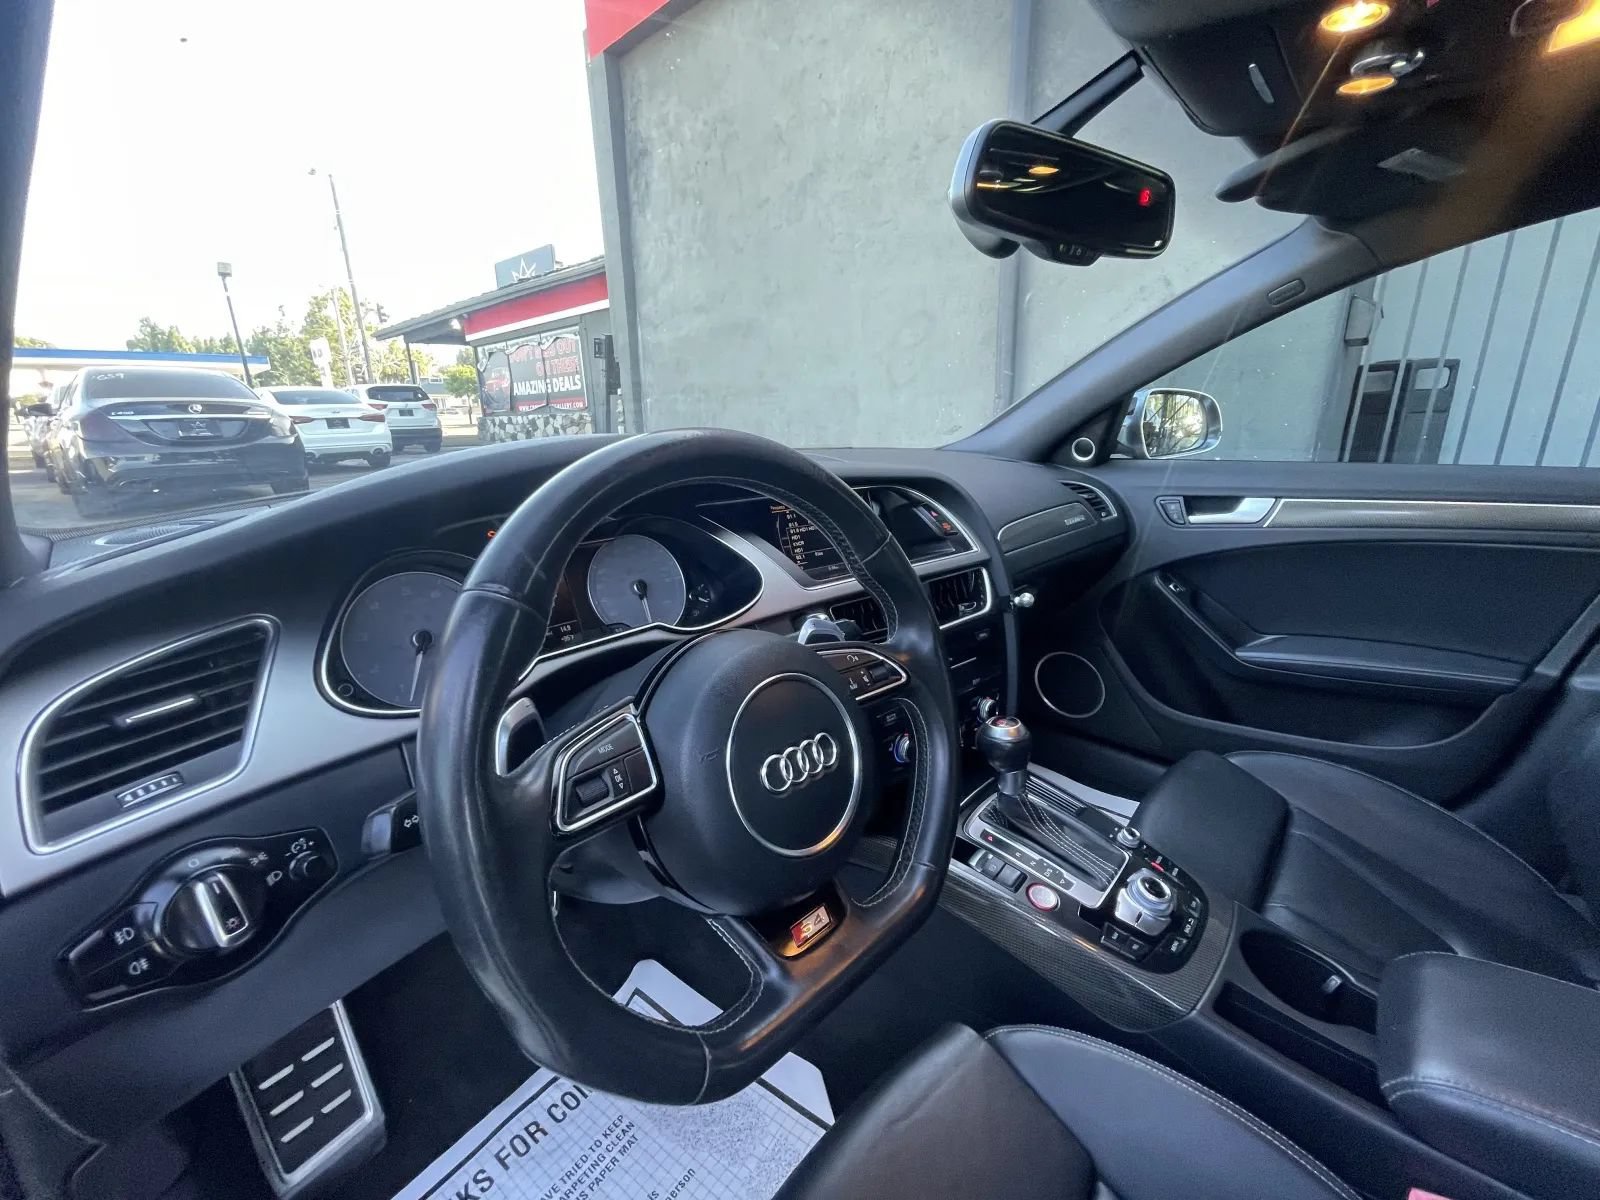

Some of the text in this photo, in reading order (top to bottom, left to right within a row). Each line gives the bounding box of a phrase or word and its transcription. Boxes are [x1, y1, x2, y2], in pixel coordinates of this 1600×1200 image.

[513, 374, 582, 396] AMAZING DEALS
[493, 1120, 548, 1172] FOR
[559, 1153, 589, 1185] TRIED
[587, 1139, 603, 1154] TO
[601, 1114, 625, 1140] KEEP
[588, 1156, 620, 1192] PAPER
[618, 1134, 639, 1157] MAT
[605, 1121, 636, 1153] CLEAN
